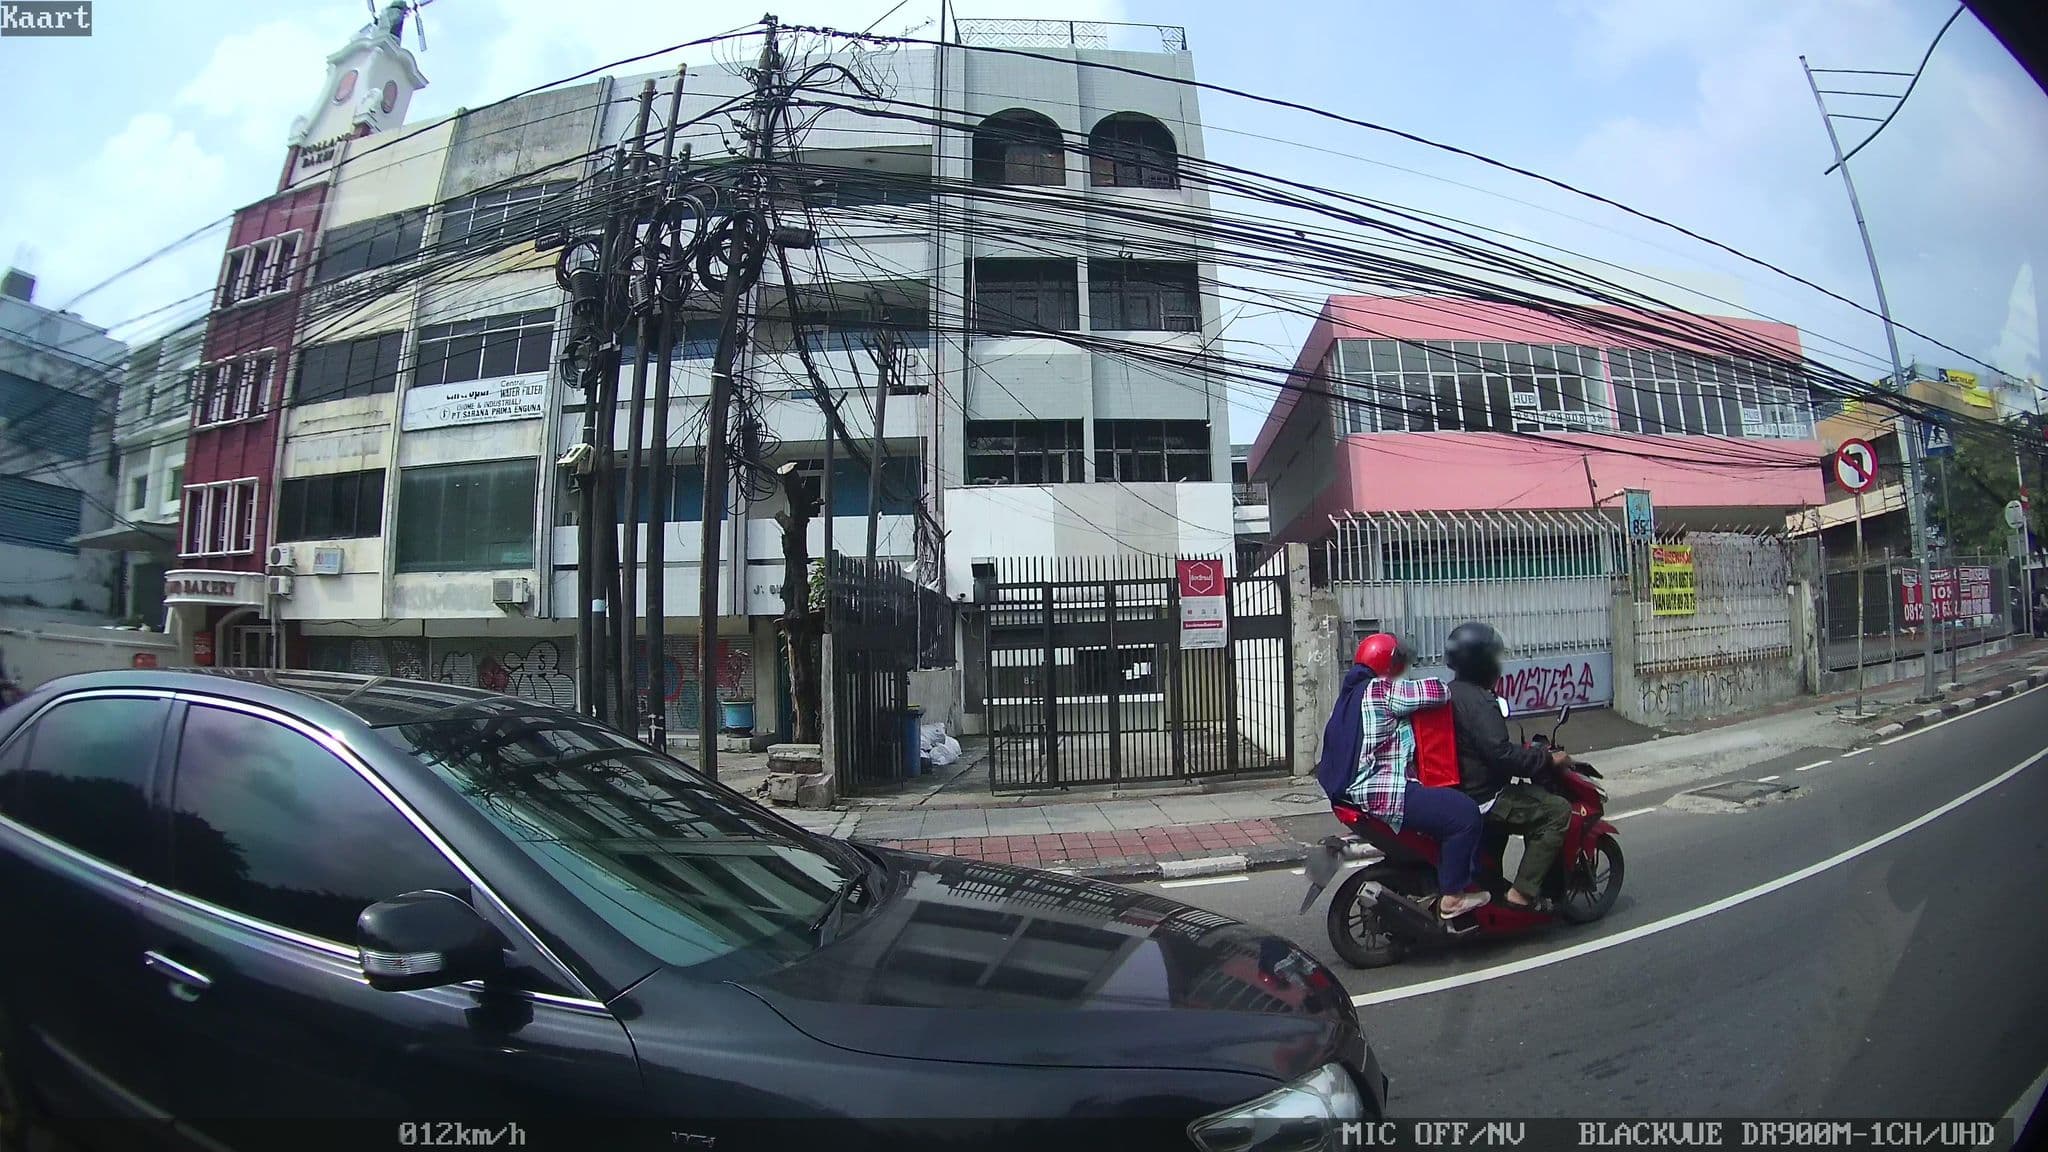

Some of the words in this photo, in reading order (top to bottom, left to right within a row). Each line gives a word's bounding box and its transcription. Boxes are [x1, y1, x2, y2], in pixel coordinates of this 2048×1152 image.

[500, 387, 520, 398] WATER
[522, 385, 543, 396] FILTER
[451, 411, 461, 420] PT
[462, 409, 489, 418] SARANA
[491, 407, 512, 416] PRIMA
[514, 404, 542, 414] ENGUNA
[184, 580, 236, 596] BAKERY
